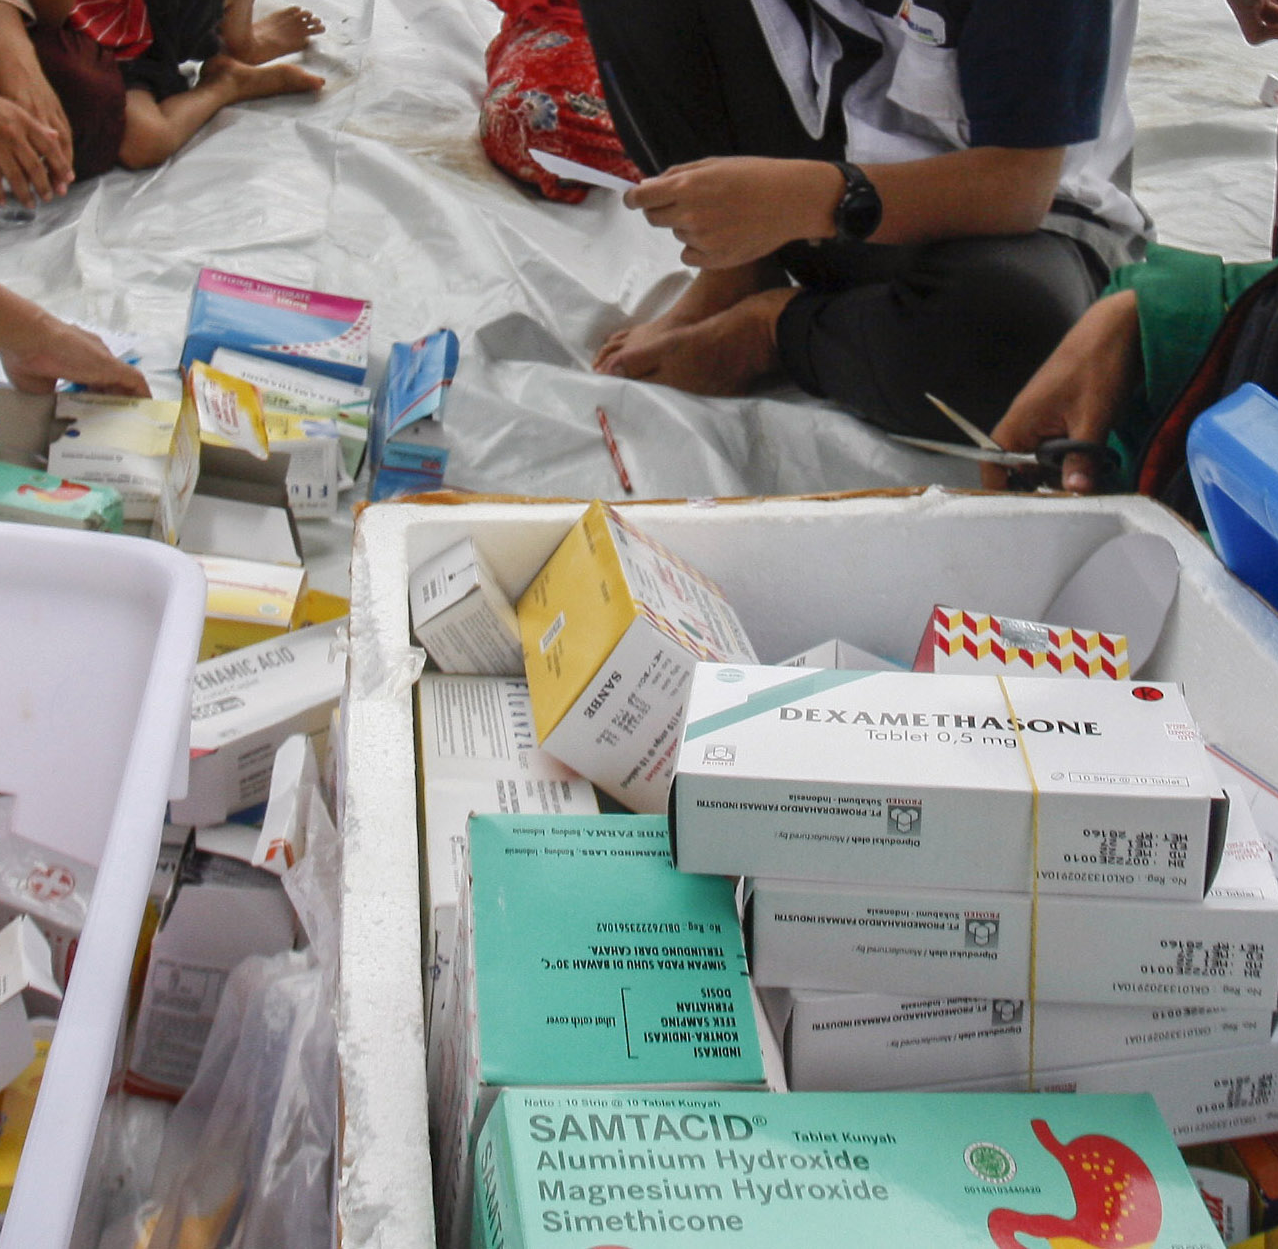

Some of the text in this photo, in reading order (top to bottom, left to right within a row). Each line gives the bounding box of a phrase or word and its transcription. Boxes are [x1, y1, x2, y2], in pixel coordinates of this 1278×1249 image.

[191, 646, 295, 694] ENAMIC ACID
[584, 671, 622, 719] SANBE
[779, 707, 1103, 736] DEXAMETHASONE
[865, 729, 1018, 749] Tablet 0,5 mg
[696, 800, 737, 810] INDUSTRI
[789, 794, 881, 806] Sukabumi Indonesia
[738, 803, 778, 813] FARMASI
[781, 805, 867, 817] PROMEDRAHARDJO
[851, 835, 871, 845] oleh
[872, 835, 921, 847] Diproduksi
[774, 913, 816, 923] INDUSTRI
[817, 916, 856, 926] FARMASI
[633, 946, 658, 956] DARI
[662, 947, 724, 957] TERLINDUNG
[573, 959, 610, 969] BAWAH
[613, 960, 623, 969] DI
[627, 960, 654, 970] SUHU
[657, 961, 684, 970] PADA
[688, 961, 726, 971] SIMPAN
[701, 987, 731, 998] DOSIS
[676, 1002, 734, 1012] PERHATIAN
[595, 1017, 616, 1028] Lihat
[661, 1017, 736, 1027] EFEK SAMPING
[644, 1032, 739, 1043] KONTRA-INDIKASI
[694, 1047, 741, 1058] INDIKASI
[582, 1098, 609, 1109] Strip
[642, 1099, 676, 1108] Tablet
[678, 1099, 721, 1110] Kunyah
[793, 1131, 897, 1146] Tablet Kunyah
[537, 1150, 869, 1174] Aluminium Hydroxide
[538, 1178, 890, 1206] Magnesium Hydroxide
[542, 1210, 744, 1233] Simethicone
